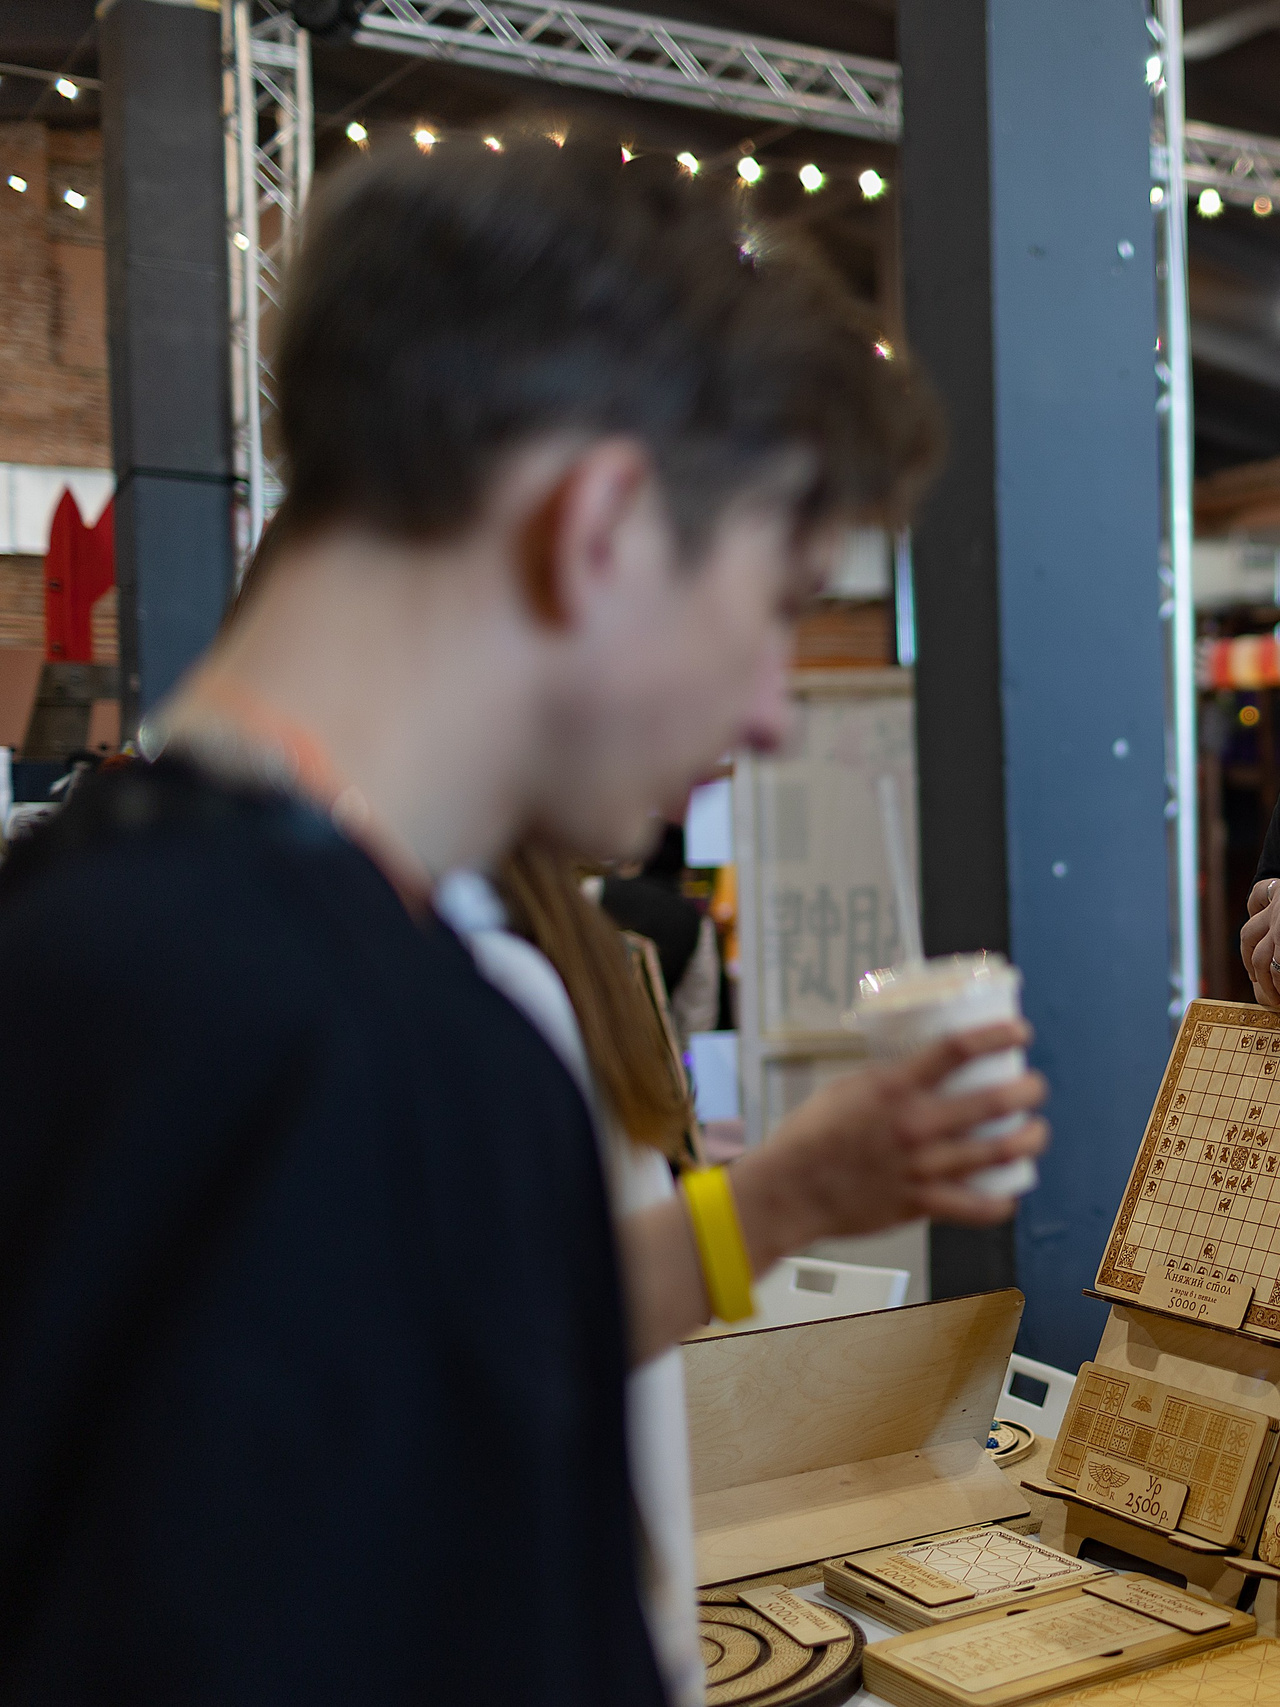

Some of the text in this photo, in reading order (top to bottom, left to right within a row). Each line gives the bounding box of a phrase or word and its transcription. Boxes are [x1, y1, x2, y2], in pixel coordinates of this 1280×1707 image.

[1164, 1268, 1232, 1295] Княжий стол
[1167, 1296, 1197, 1312] 5000
[1146, 1475, 1162, 1500] Ур
